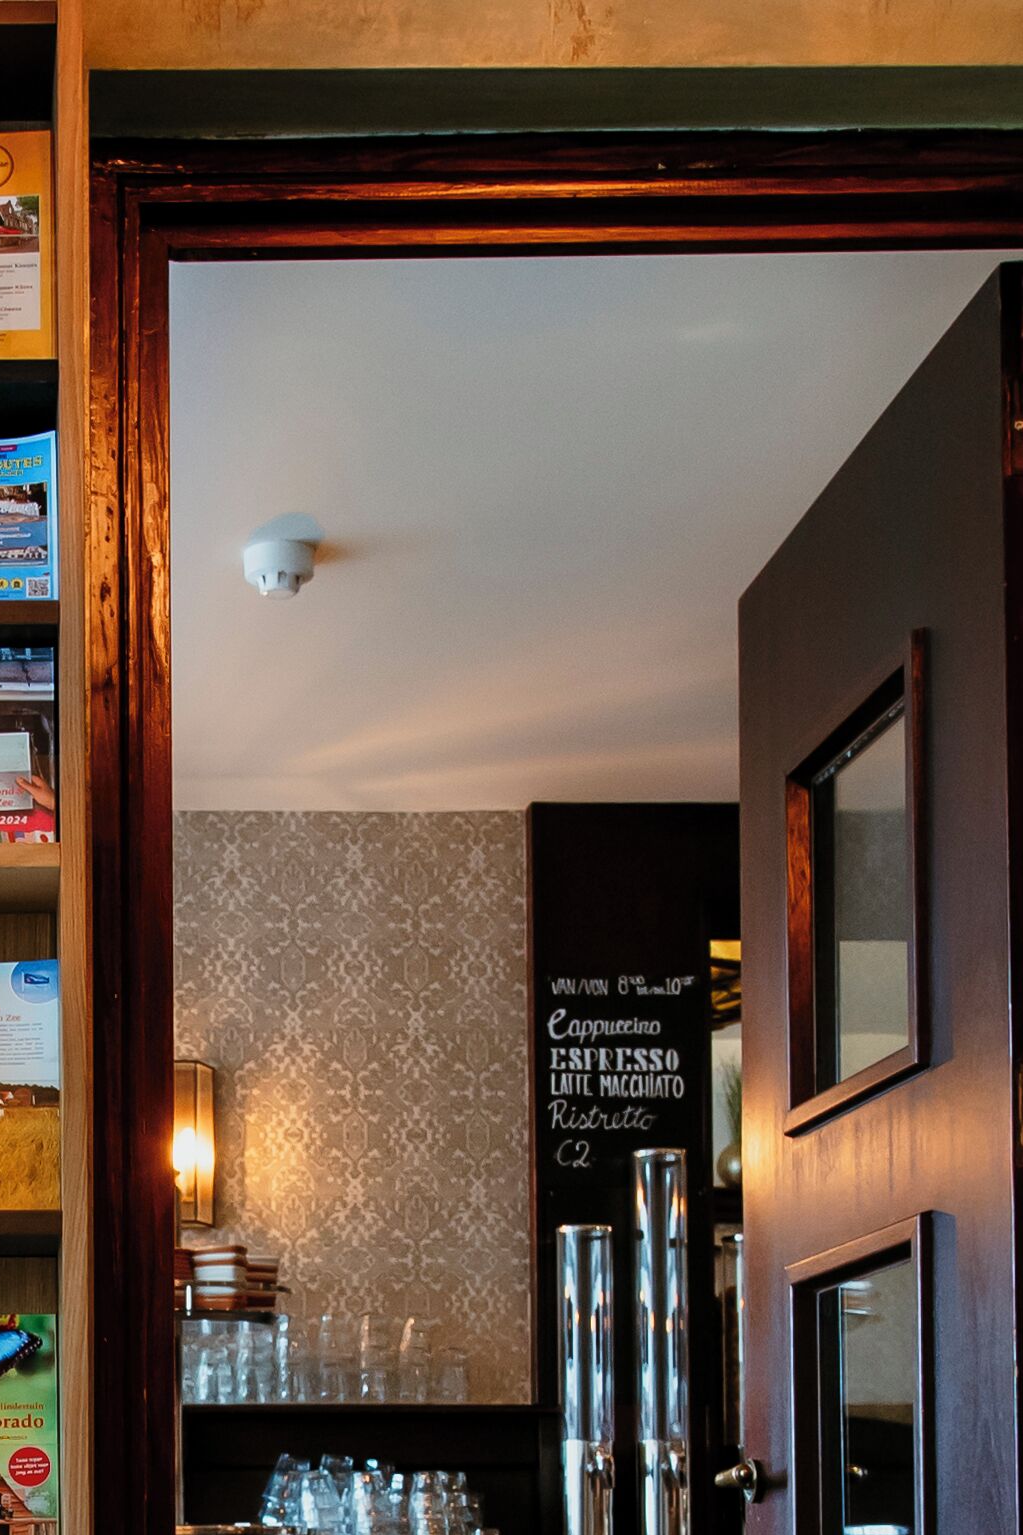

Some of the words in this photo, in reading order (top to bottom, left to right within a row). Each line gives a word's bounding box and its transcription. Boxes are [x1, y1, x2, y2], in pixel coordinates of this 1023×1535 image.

[0, 816, 28, 824] 2024
[547, 1008, 661, 1044] Cappuccino
[550, 1048, 680, 1072] ESPRESSO
[551, 1072, 593, 1096] LATTE
[600, 1073, 685, 1099] MACCHIATO
[547, 1099, 657, 1130] Ristretto
